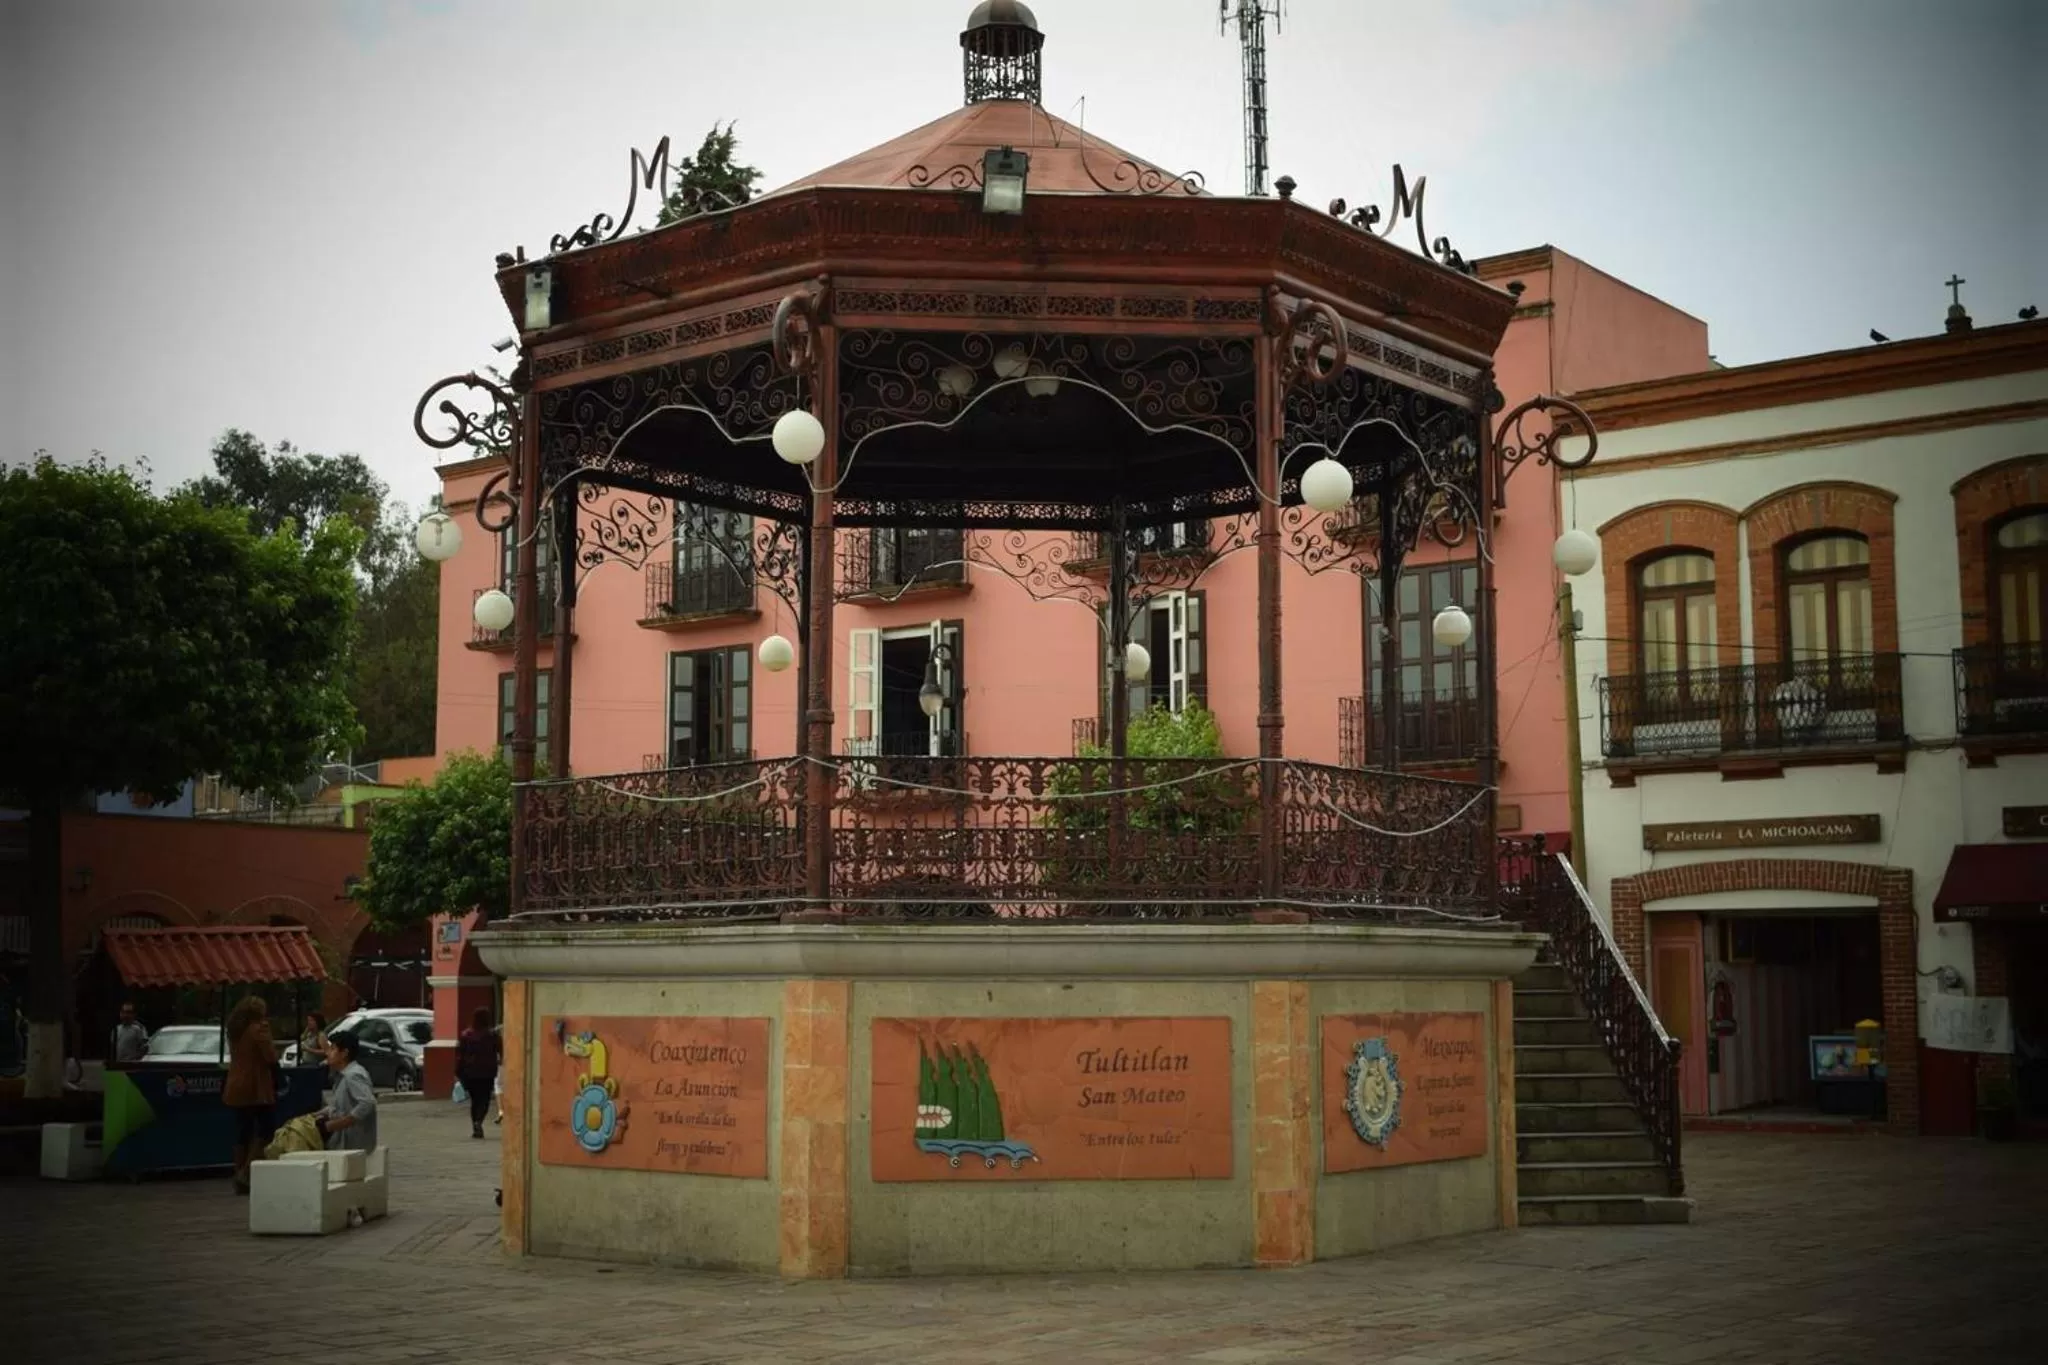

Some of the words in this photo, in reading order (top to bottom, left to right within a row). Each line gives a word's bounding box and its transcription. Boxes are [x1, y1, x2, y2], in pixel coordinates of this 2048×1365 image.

[1738, 827, 1754, 839] LA
[1762, 823, 1854, 838] MICHOACANA
[1075, 1045, 1190, 1074] Tultitlan
[654, 1078, 673, 1096] La
[1077, 1086, 1117, 1109] San
[1122, 1086, 1187, 1105] Mateo
